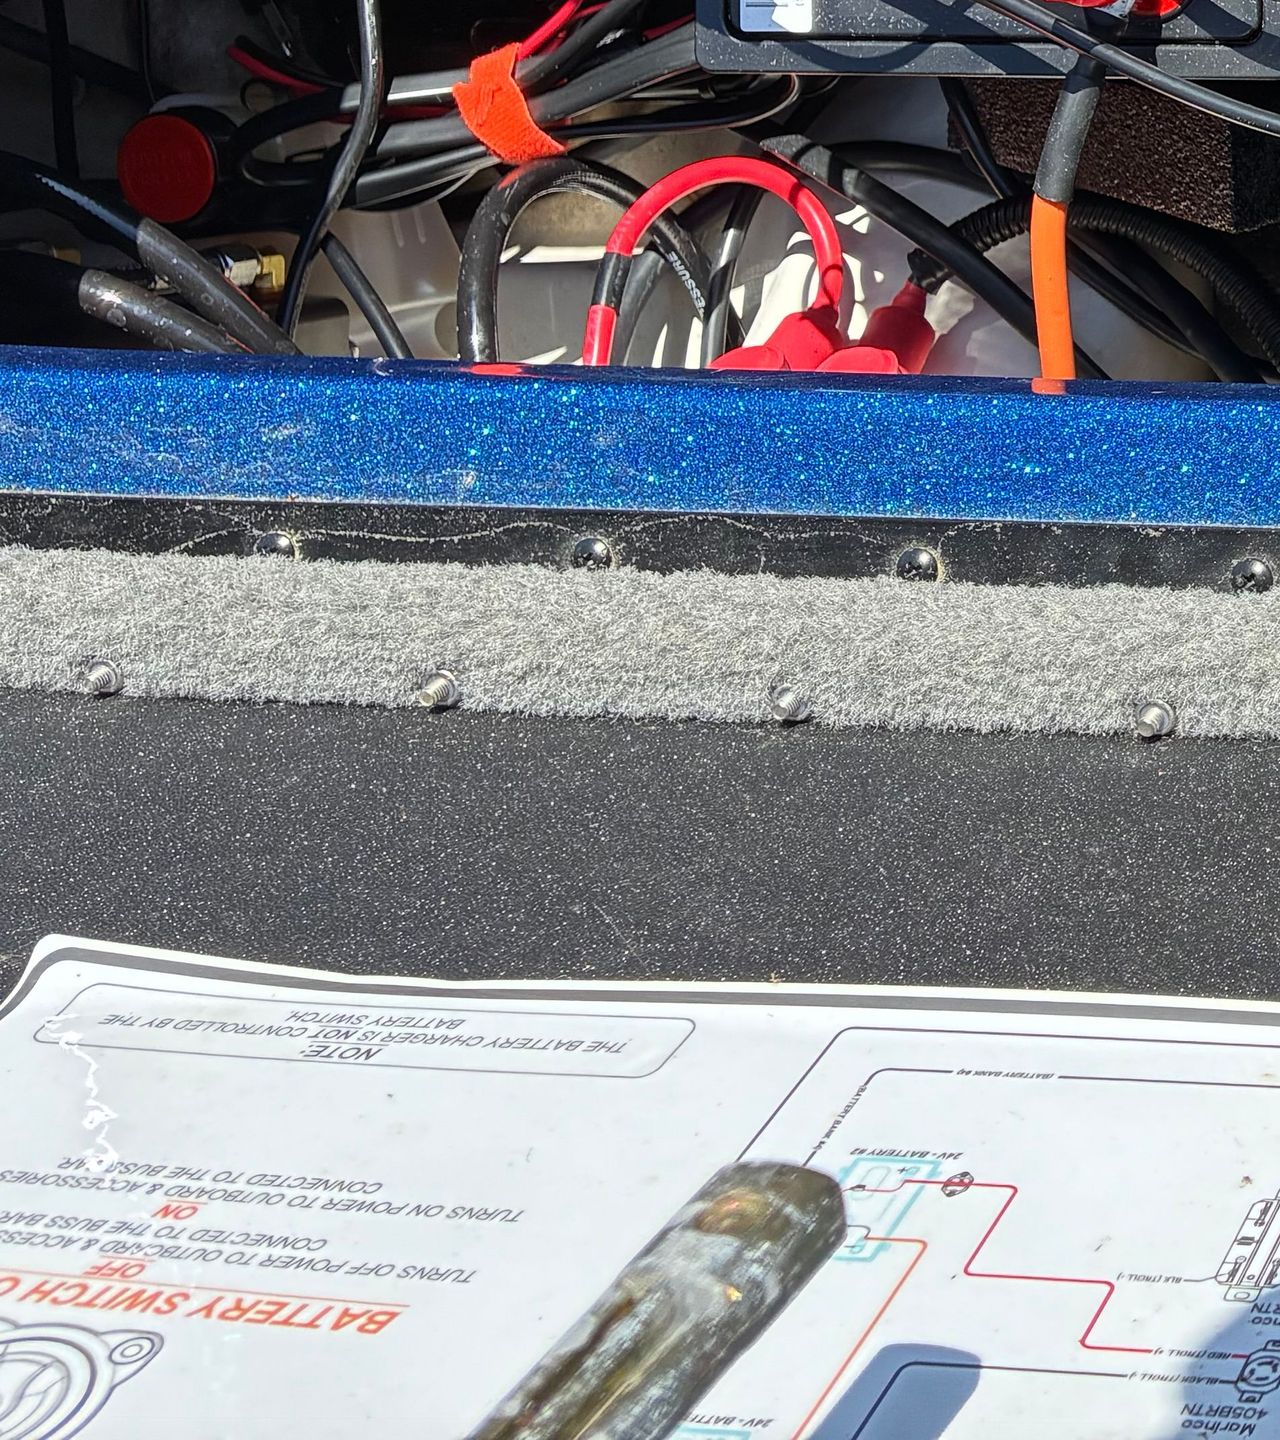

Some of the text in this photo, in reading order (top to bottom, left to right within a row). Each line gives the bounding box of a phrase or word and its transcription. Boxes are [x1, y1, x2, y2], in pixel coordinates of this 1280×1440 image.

[667, 251, 706, 321] ESSURE
[98, 1014, 629, 1054] THE BATTERY CHARGER NOT CONTROLLED BY THE
[366, 1015, 466, 1030] BATTERY
[298, 1044, 382, 1061] NOTE:
[870, 1148, 930, 1159] BATTERY
[168, 1166, 384, 1195] CONNECTED TO THE
[150, 1204, 200, 1220] ON
[164, 1184, 525, 1223] TURNS ON POWER TO OUTBOARD
[44, 1215, 328, 1252] CONNECTED TO THE BUSS
[80, 1262, 147, 1279] OFF
[223, 1251, 477, 1283] TURNS OFF POWER TO
[18, 1279, 190, 1316] SWITCH
[184, 1295, 402, 1335] BATTERY
[1180, 1403, 1269, 1420] 405BRTN
[1181, 1419, 1256, 1436] Marinco
